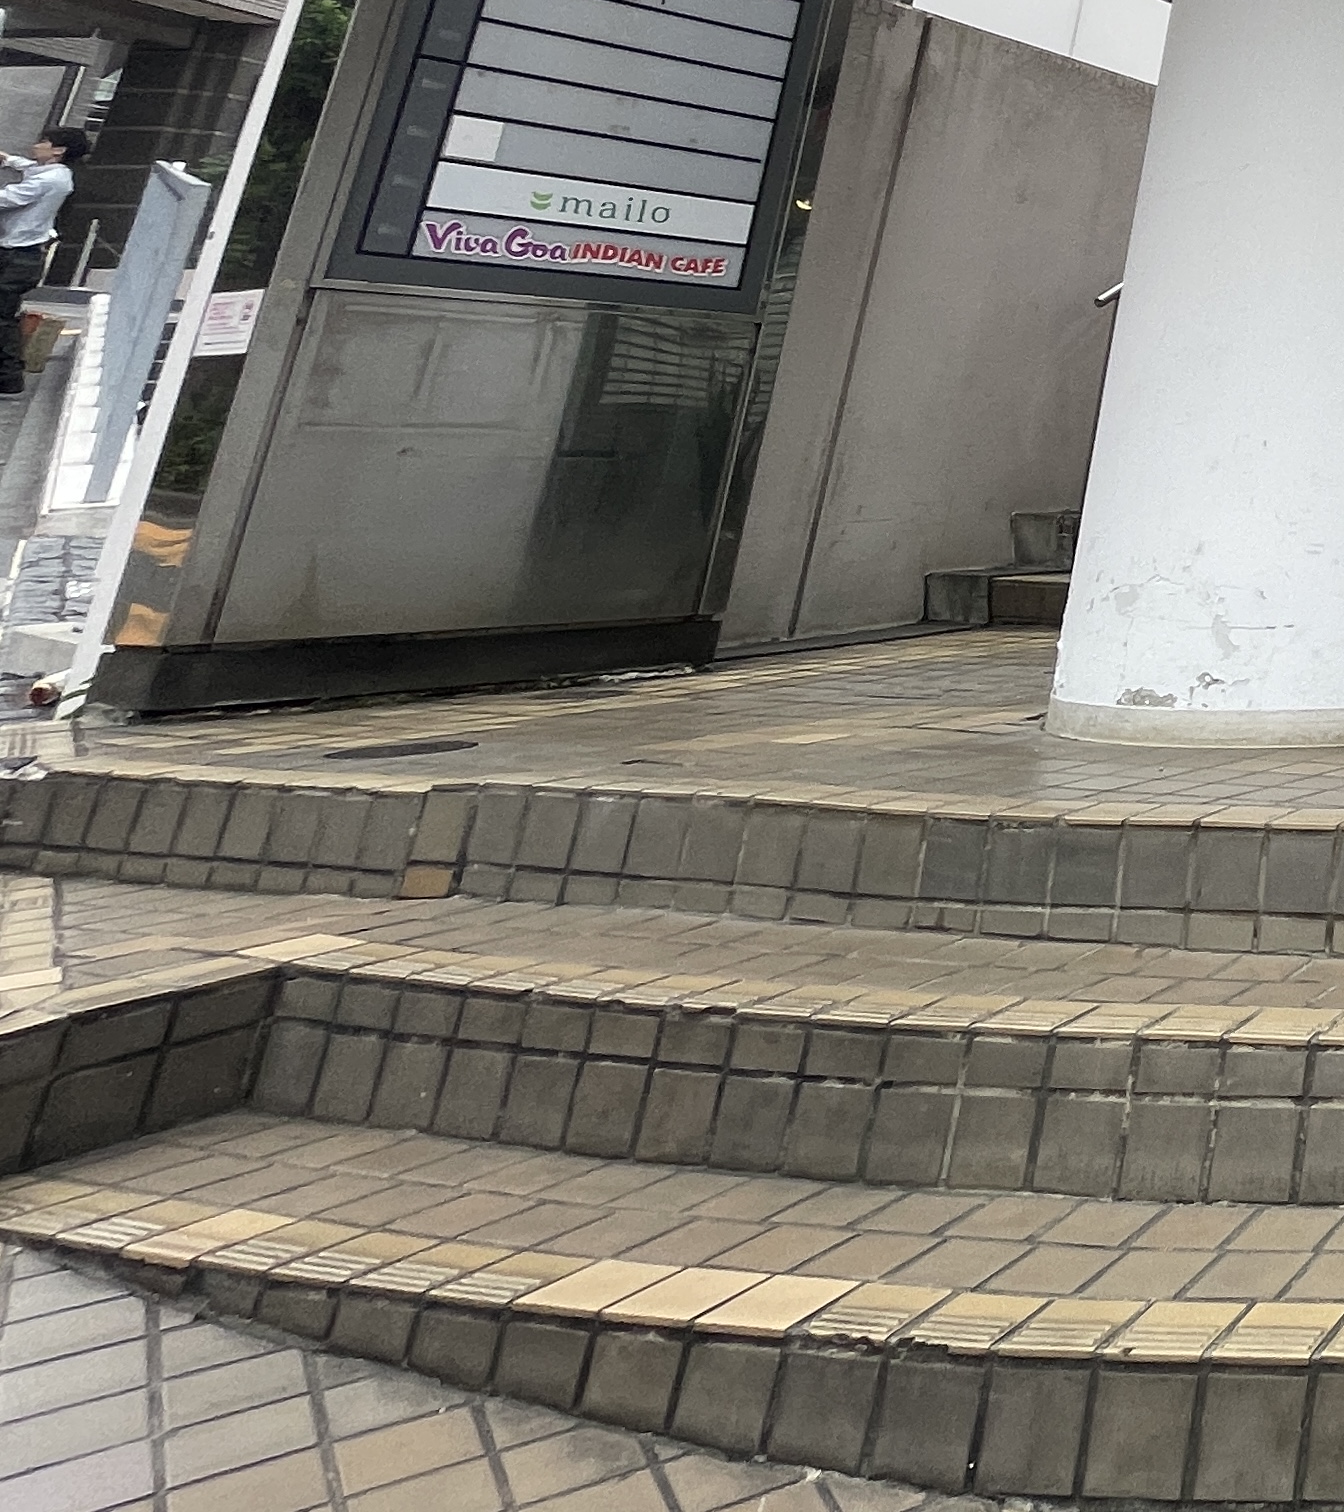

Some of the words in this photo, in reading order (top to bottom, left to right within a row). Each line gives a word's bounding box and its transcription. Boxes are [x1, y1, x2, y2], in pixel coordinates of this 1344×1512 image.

[558, 194, 671, 224] mailo
[425, 222, 498, 255] Viva
[504, 228, 568, 262] Goa
[571, 243, 664, 271] INDIAN
[670, 255, 726, 275] CAFE
